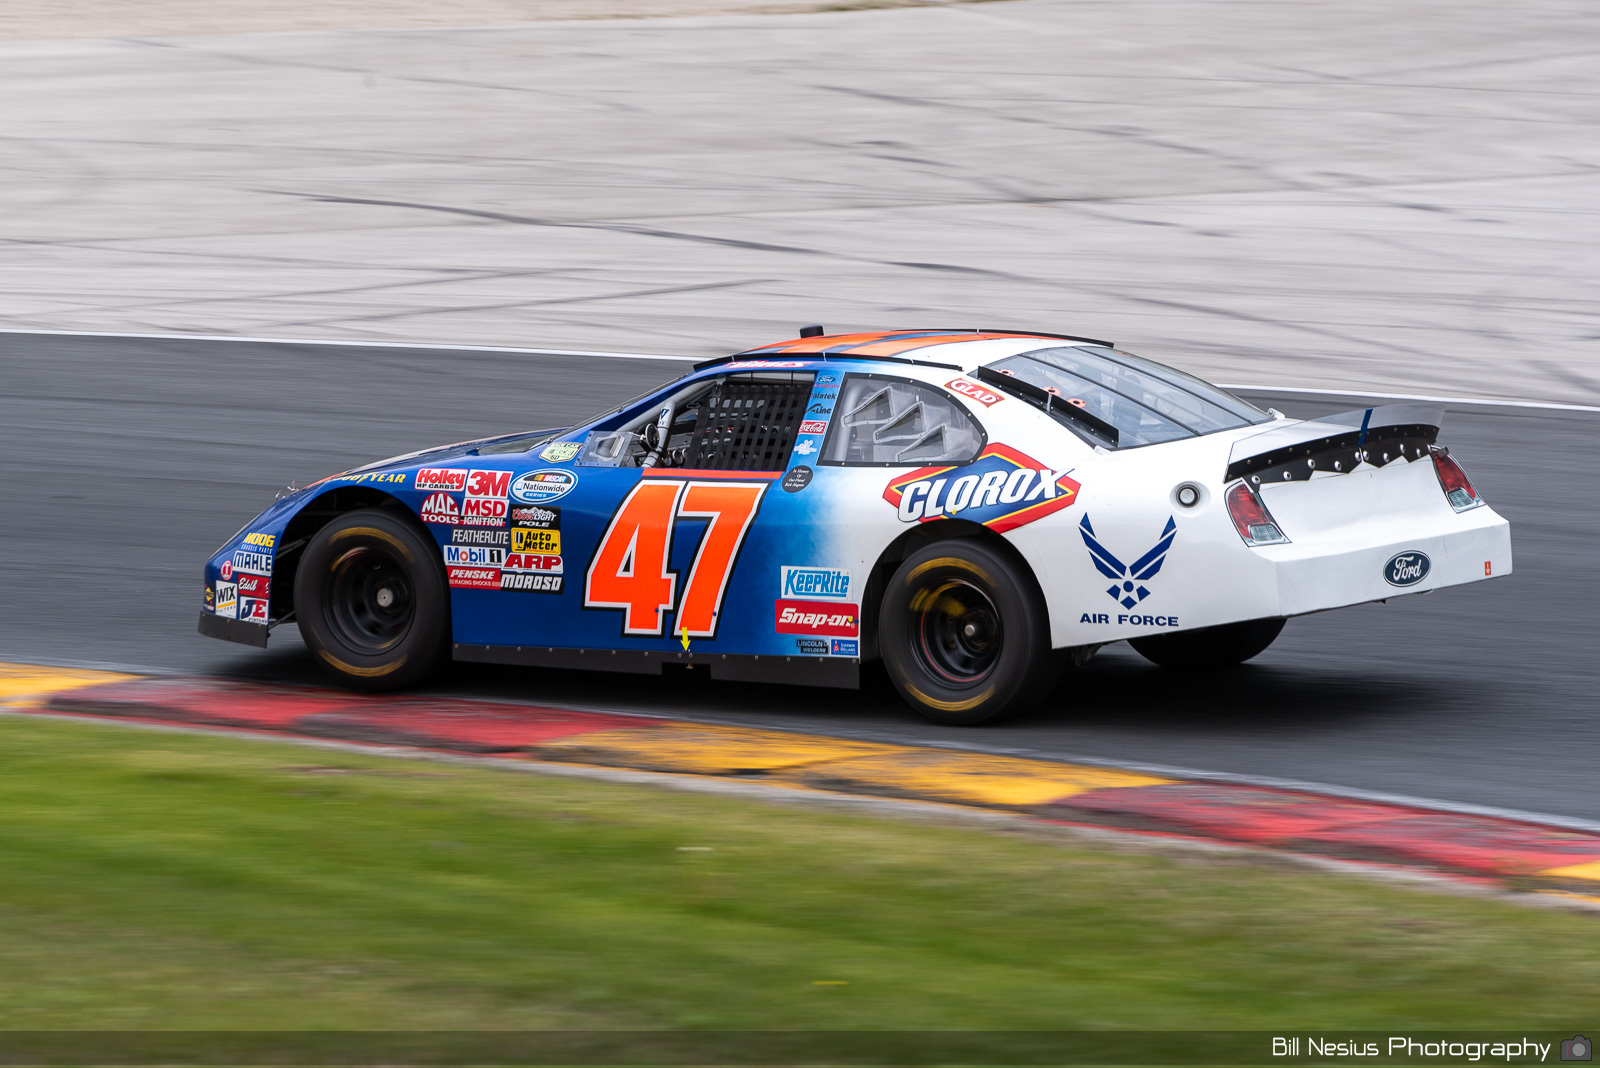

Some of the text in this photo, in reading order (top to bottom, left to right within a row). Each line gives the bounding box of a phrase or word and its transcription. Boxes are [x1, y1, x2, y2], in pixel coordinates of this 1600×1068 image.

[950, 378, 999, 404] GLAD
[417, 469, 466, 490] Holley
[467, 471, 512, 497] 3M
[522, 482, 565, 492] Nationwide
[898, 467, 1075, 523] CLOROX
[421, 493, 459, 516] MAC
[463, 499, 506, 517] MSD
[421, 514, 460, 525] TOOLS
[463, 516, 503, 526] IGNITION
[512, 508, 557, 522] Coors LIGHT
[242, 532, 276, 547] MOOG
[452, 529, 509, 544] FEATHERLITE
[525, 531, 552, 541] Auto
[447, 547, 486, 562] Mobil
[524, 541, 558, 551] Meter
[233, 552, 272, 572] MAHLE
[503, 554, 562, 570] ARP
[584, 479, 768, 637] 47
[450, 569, 496, 580] PENSKE
[1393, 555, 1422, 581] Ford
[500, 573, 562, 591] MOROSO
[216, 585, 236, 603] WIX
[241, 599, 267, 619] JE
[779, 607, 853, 628] Snap-on
[1080, 613, 1179, 627] AIR FORCE
